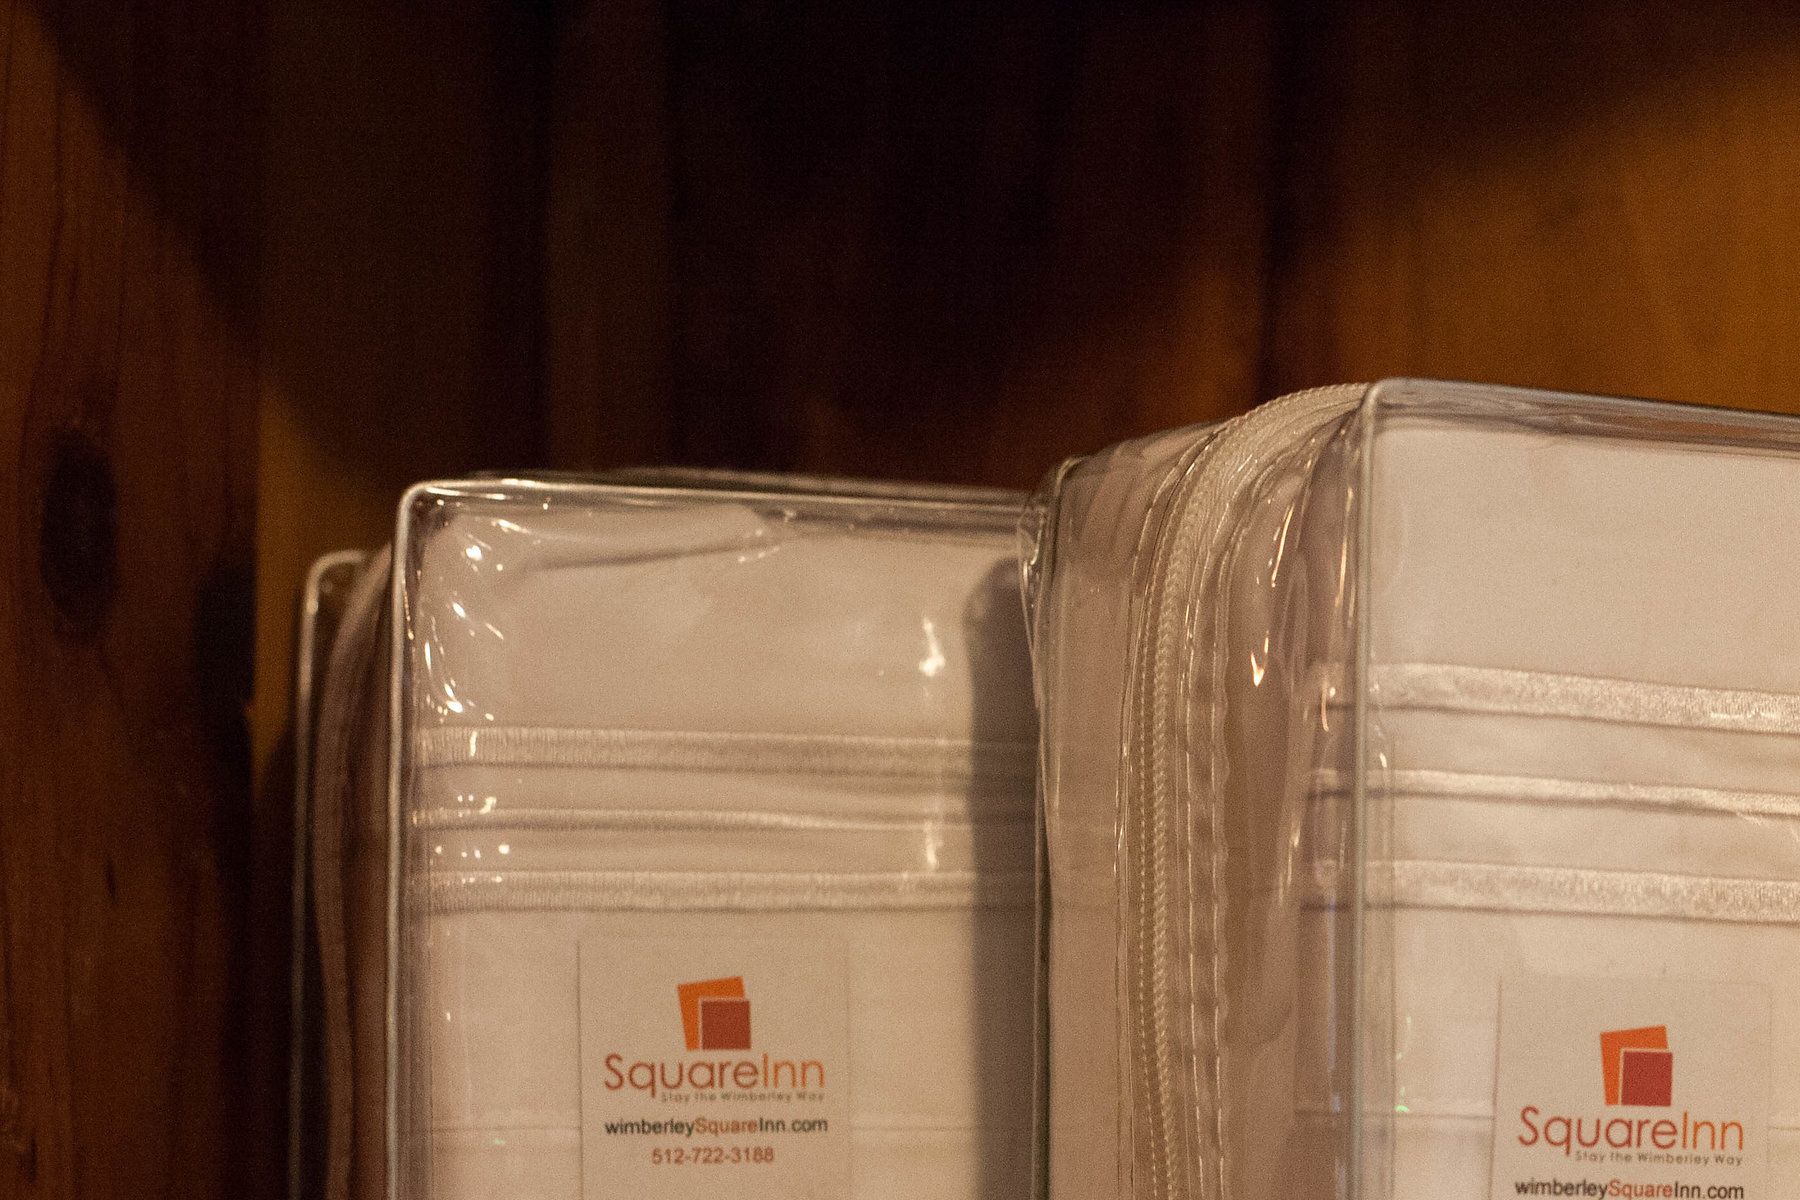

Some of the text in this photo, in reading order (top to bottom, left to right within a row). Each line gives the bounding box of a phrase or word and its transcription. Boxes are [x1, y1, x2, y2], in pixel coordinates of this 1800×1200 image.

[604, 1052, 826, 1098] SquareInn
[604, 1117, 828, 1137] wimberleySquareInn.com
[1518, 1106, 1744, 1156] SquareInn
[652, 1147, 774, 1164] 512-722-3188
[1610, 1152, 1632, 1162] the
[1715, 1156, 1743, 1166] Way
[1515, 1179, 1744, 1200] wimberleySquareInn.com
